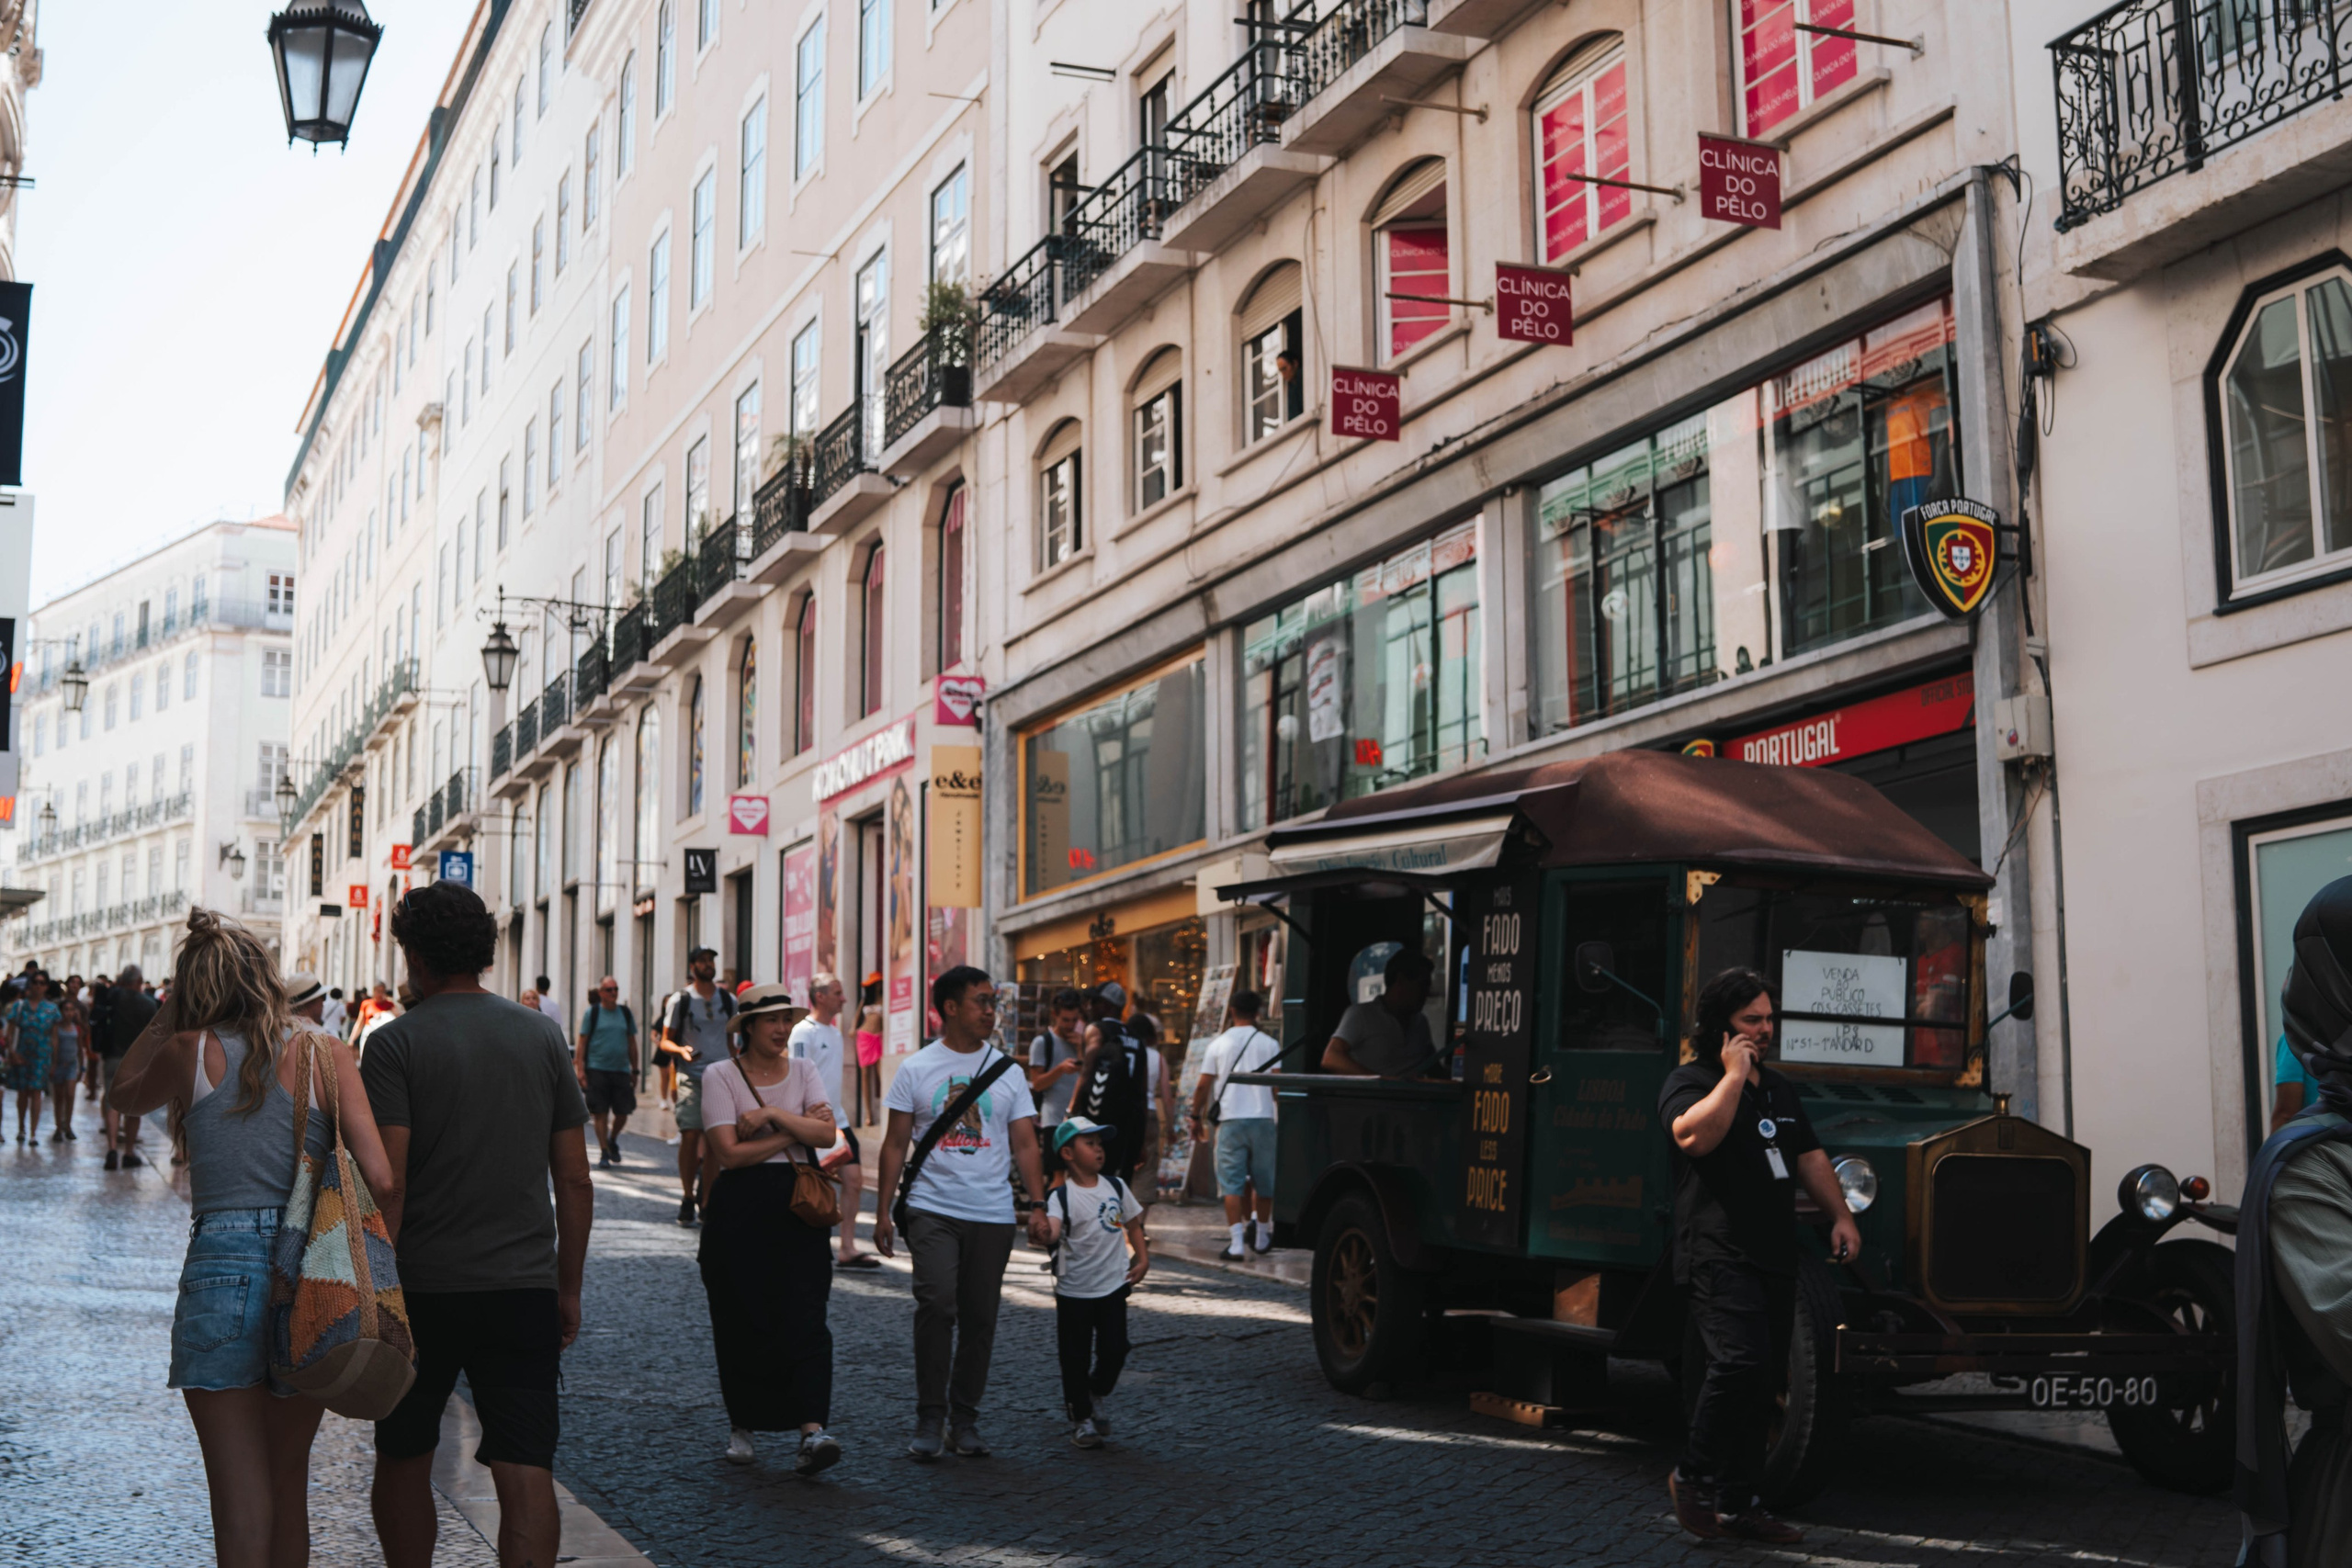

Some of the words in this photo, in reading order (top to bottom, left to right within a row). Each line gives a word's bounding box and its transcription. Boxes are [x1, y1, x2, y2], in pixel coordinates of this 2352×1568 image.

[1700, 149, 1779, 177] CLÍNICA
[1725, 175, 1756, 196] DO
[1716, 195, 1767, 220] PÊLO
[1498, 276, 1570, 300] CLÍNICA
[1521, 299, 1549, 319] DO
[1511, 318, 1560, 340] PÊLO
[1332, 377, 1399, 399] CLÍNICA
[1352, 398, 1379, 416] DO
[1343, 414, 1387, 434] PÊLO
[1920, 500, 1950, 521] FORÇA
[1950, 499, 1996, 525] PORTUGAL
[1392, 843, 1448, 871] Cultural
[1482, 912, 1521, 955] FADO
[1487, 962, 1511, 983] MENOS
[1823, 967, 1860, 981] VENDA
[1474, 989, 1521, 1037] PREÇO
[1483, 1063, 1503, 1084] MORE
[1473, 1090, 1510, 1134] FADO
[1479, 1140, 1498, 1161] LESS
[1466, 1166, 1508, 1212] PRICE
